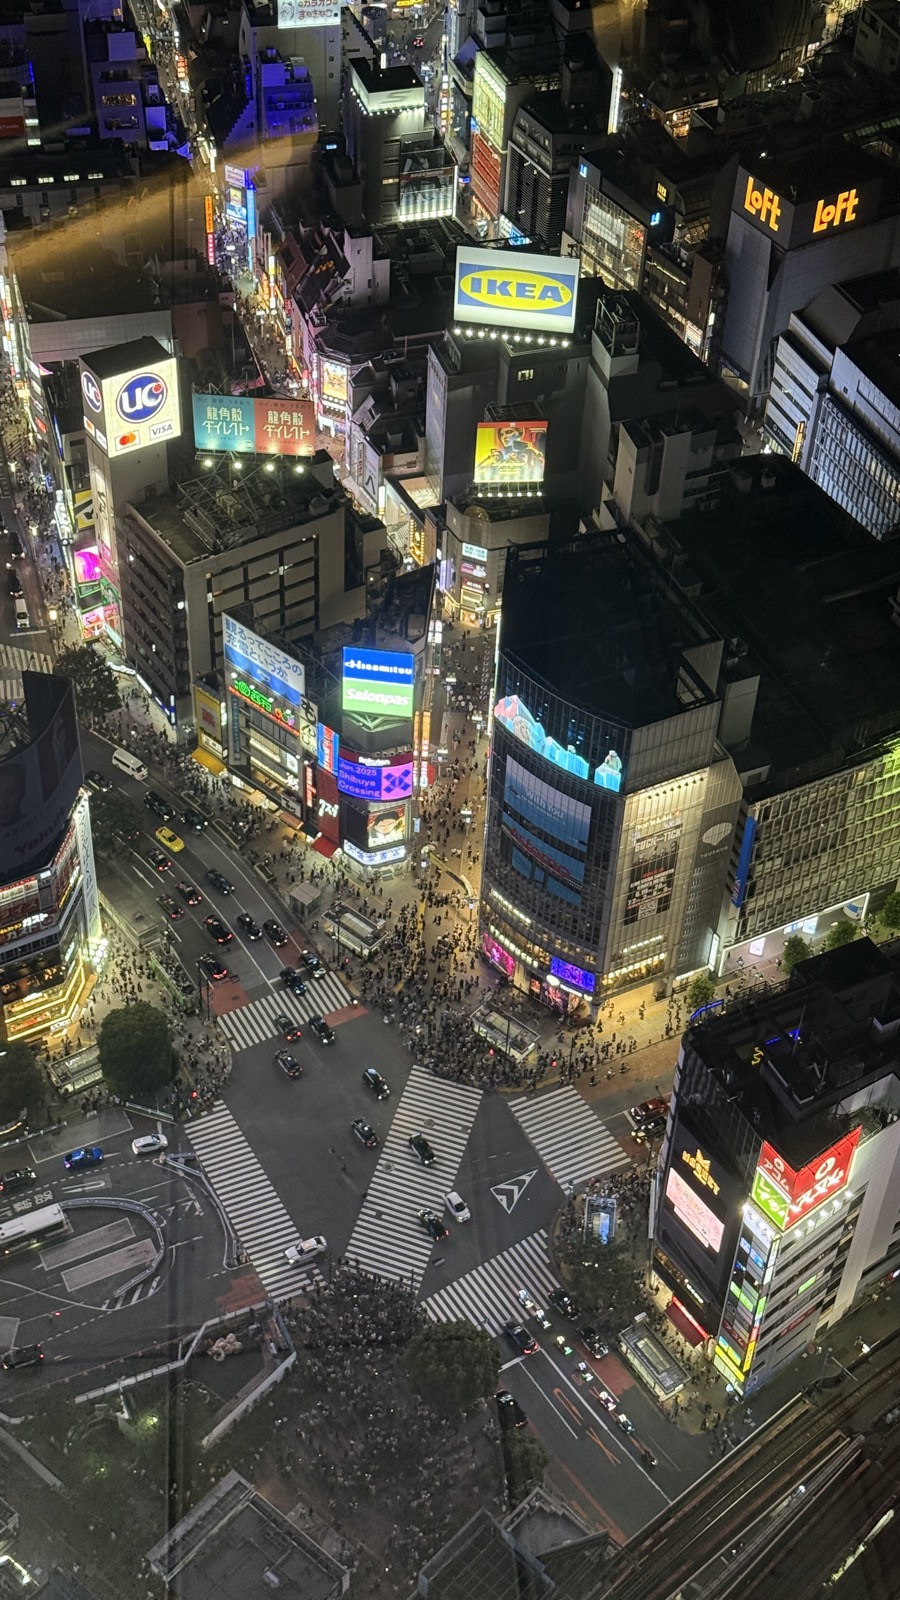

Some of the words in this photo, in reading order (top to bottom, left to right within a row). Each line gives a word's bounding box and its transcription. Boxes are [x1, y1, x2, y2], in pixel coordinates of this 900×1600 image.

[299, 9, 333, 20] まねきねこ
[470, 277, 564, 302] IKEA
[206, 406, 243, 422] 龍角散
[267, 410, 303, 426] 龍角散
[151, 423, 173, 436] VISA
[225, 617, 302, 676] 観るってこころの
[344, 659, 413, 675] Hisamitsu
[346, 688, 409, 706] Salonpas
[339, 770, 376, 787] Shibuya
[339, 780, 381, 798] Crossing
[525, 787, 546, 807] With
[547, 803, 564, 818] You
[700, 845, 728, 859] TSUTAYA
[763, 1158, 790, 1192] アコム
